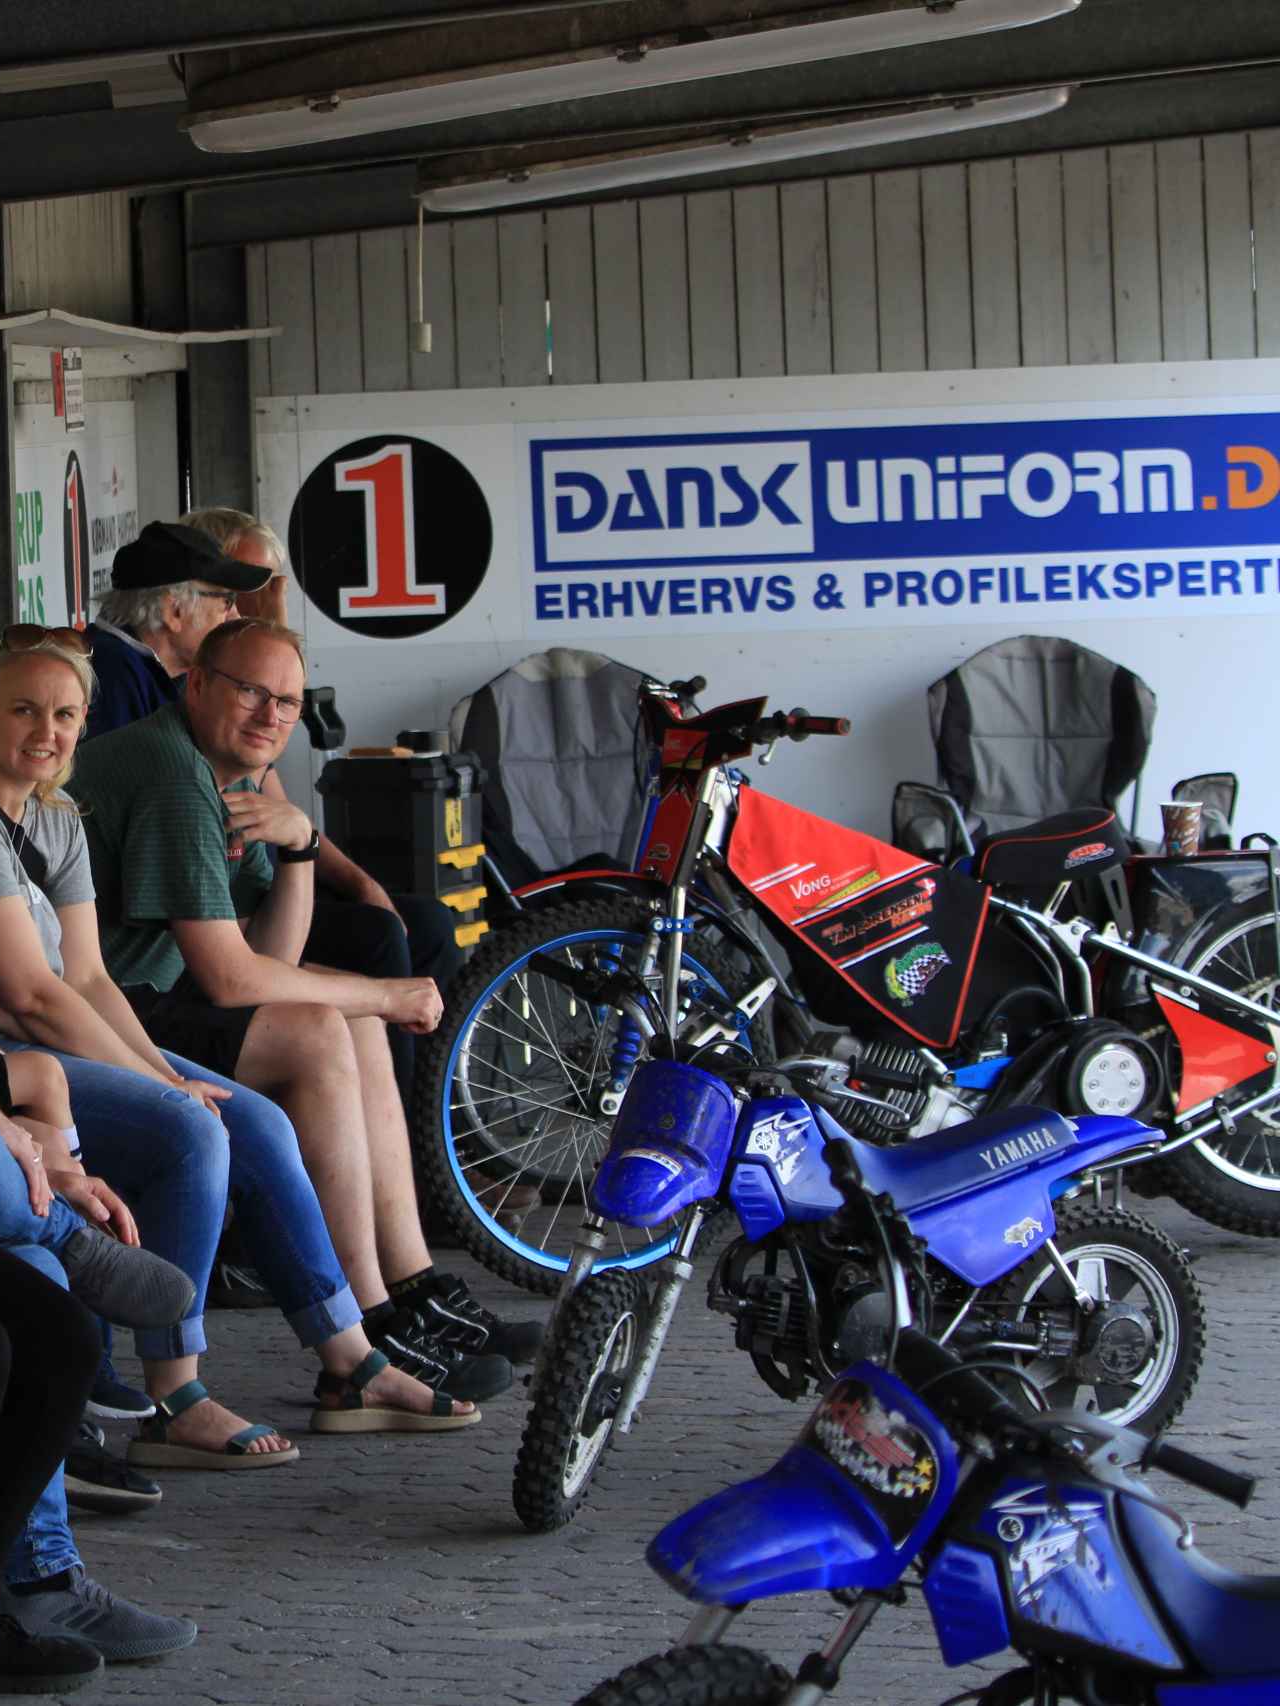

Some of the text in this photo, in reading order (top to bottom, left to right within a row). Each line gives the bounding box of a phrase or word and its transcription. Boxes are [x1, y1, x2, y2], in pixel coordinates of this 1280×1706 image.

[335, 444, 446, 618] 1
[554, 463, 802, 534] DANSK
[67, 460, 86, 632] 1
[535, 558, 1280, 620] ERHVERVS & PROFILEKSPERT
[789, 875, 832, 899] VONG
[979, 1128, 1057, 1170] YAMAHA
